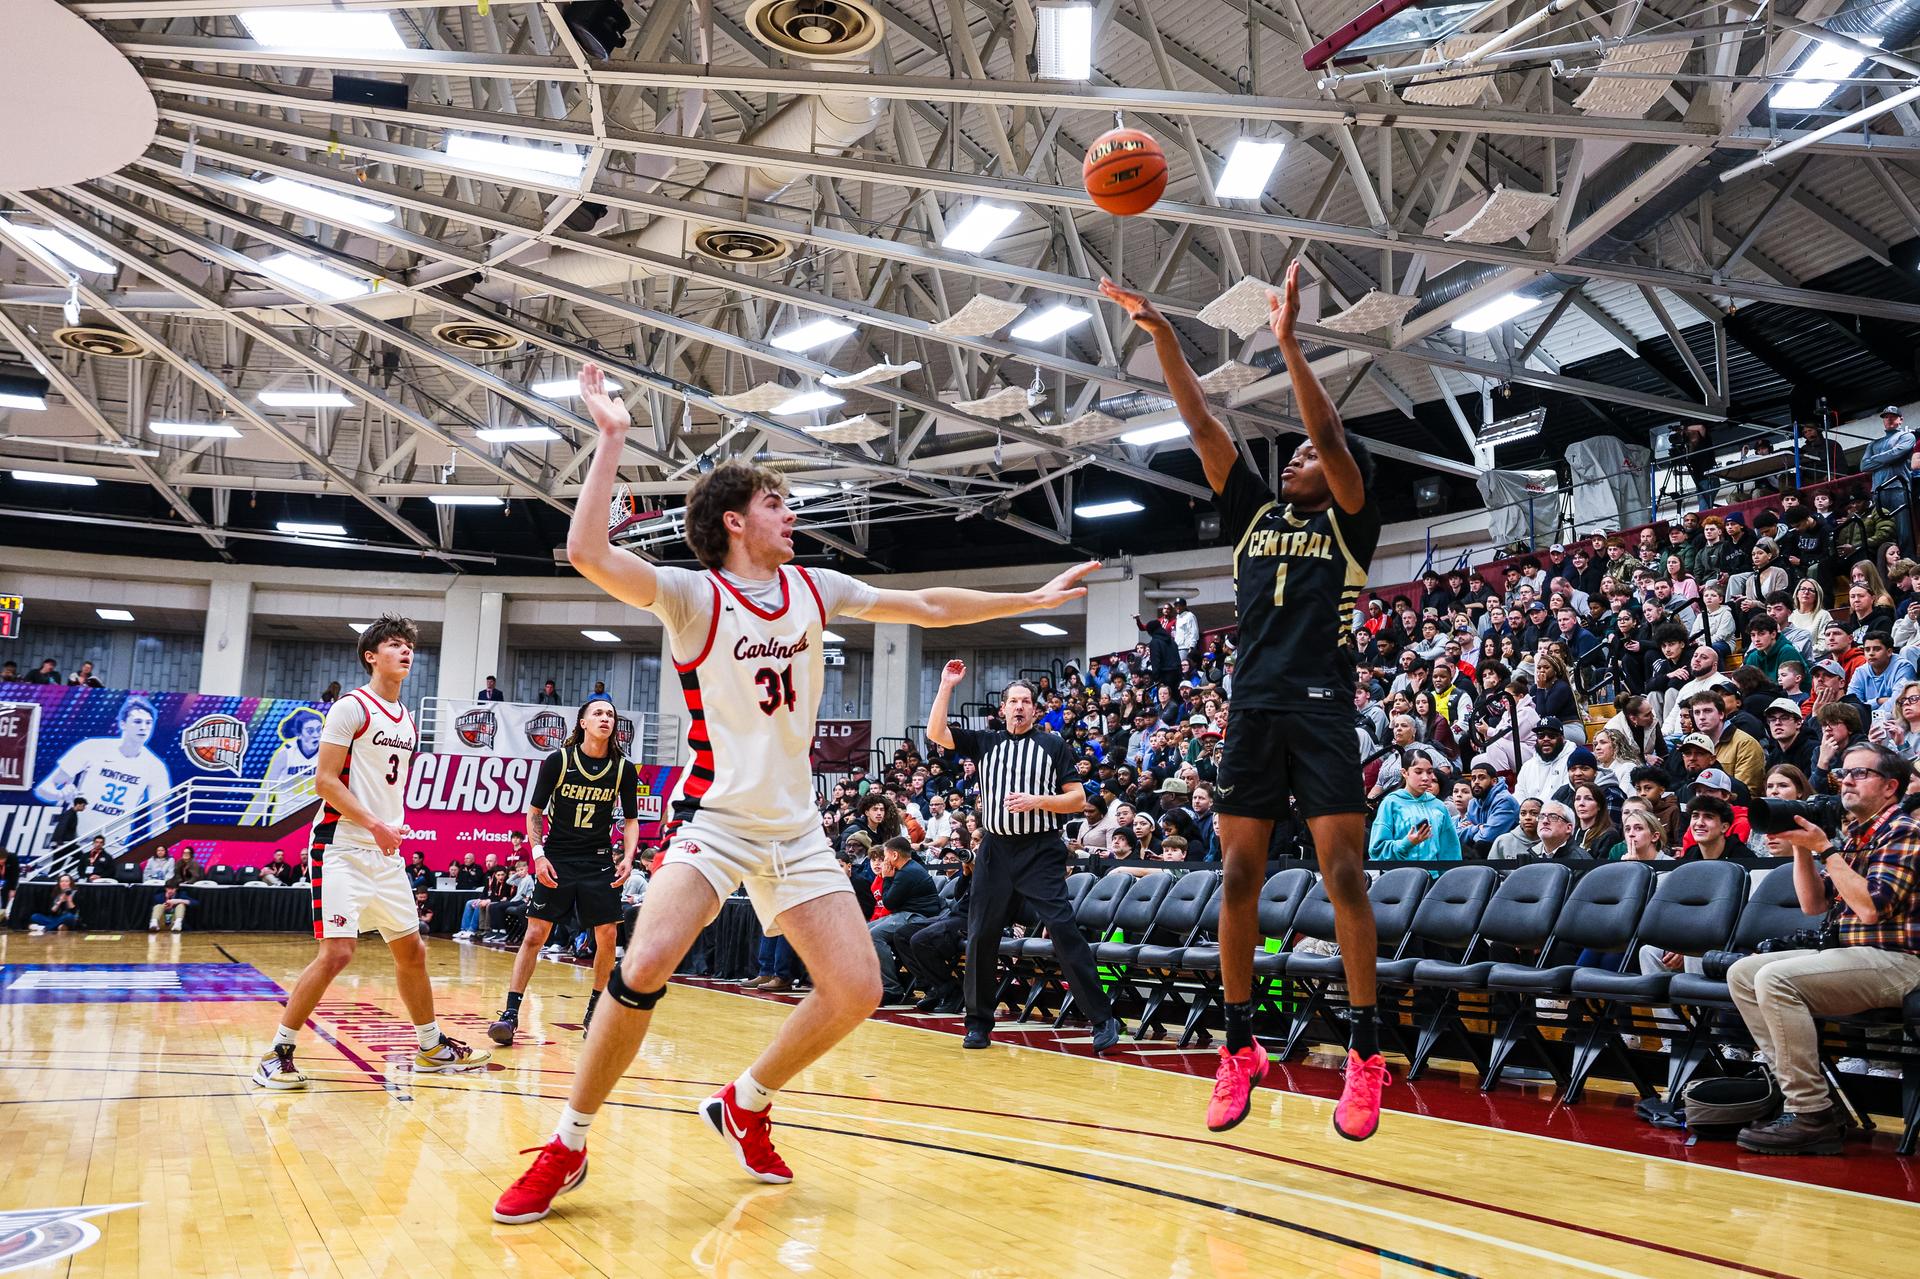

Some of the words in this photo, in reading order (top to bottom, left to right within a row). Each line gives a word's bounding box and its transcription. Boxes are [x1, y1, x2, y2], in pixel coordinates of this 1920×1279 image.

[1102, 164, 1144, 188] JET
[1247, 529, 1334, 561] CENTRAL
[1273, 562, 1289, 607] 1
[754, 663, 797, 716] 34
[0, 716, 20, 738] GE
[818, 725, 852, 737] ELD
[372, 730, 413, 751] Cardinals
[0, 757, 20, 779] ALL
[385, 753, 400, 786] 3
[100, 782, 128, 806] 32
[405, 752, 548, 816] CLASSI
[560, 783, 616, 802] CENTRAL
[574, 803, 596, 829] 12
[637, 797, 660, 813] ALL
[0, 804, 63, 858] THE
